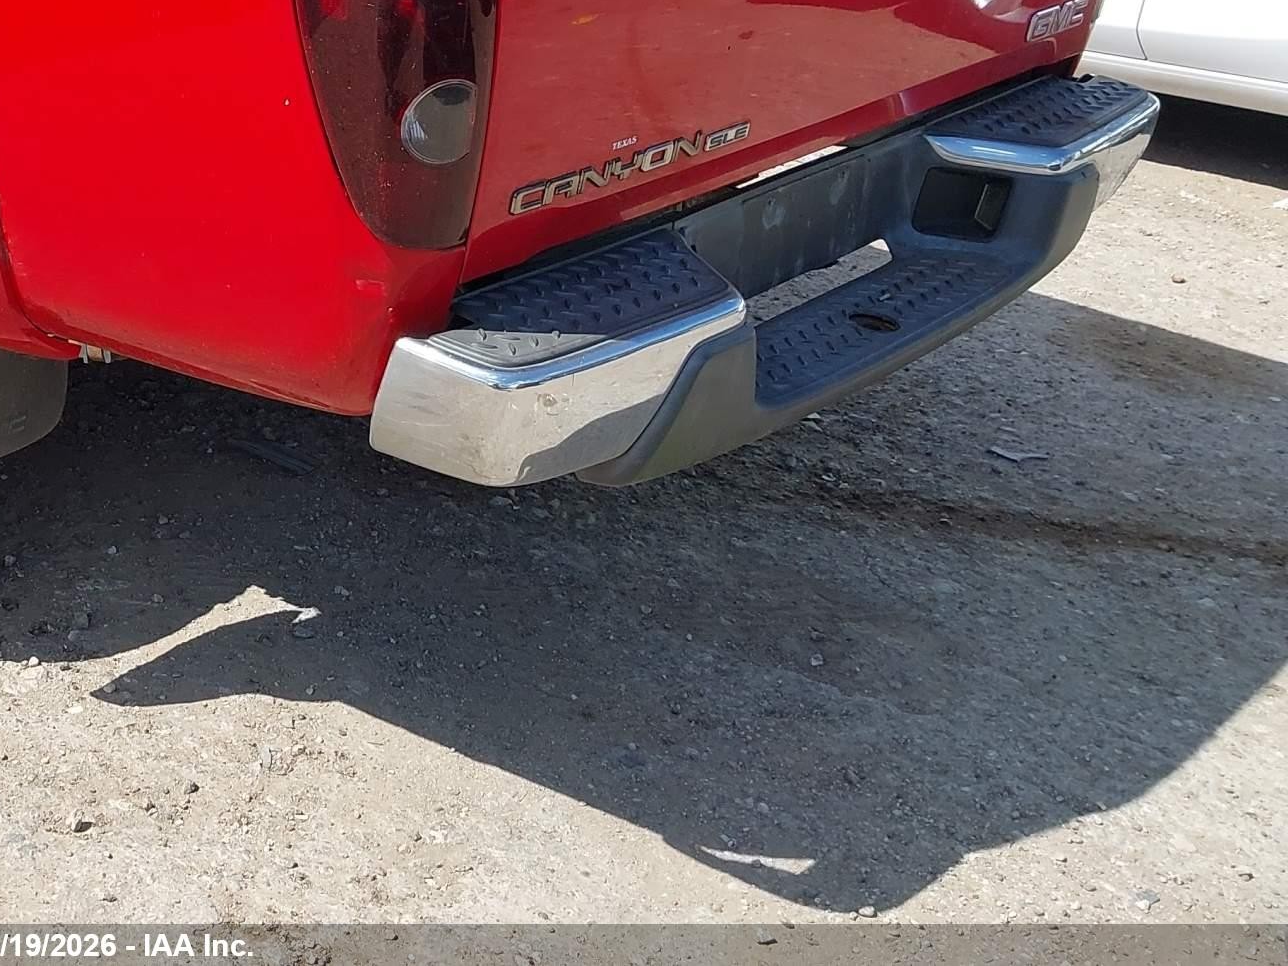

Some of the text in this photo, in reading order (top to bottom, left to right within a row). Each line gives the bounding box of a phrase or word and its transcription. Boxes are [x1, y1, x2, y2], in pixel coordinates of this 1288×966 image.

[510, 121, 751, 216] CANYON SLE
[612, 136, 638, 151] TEXAS
